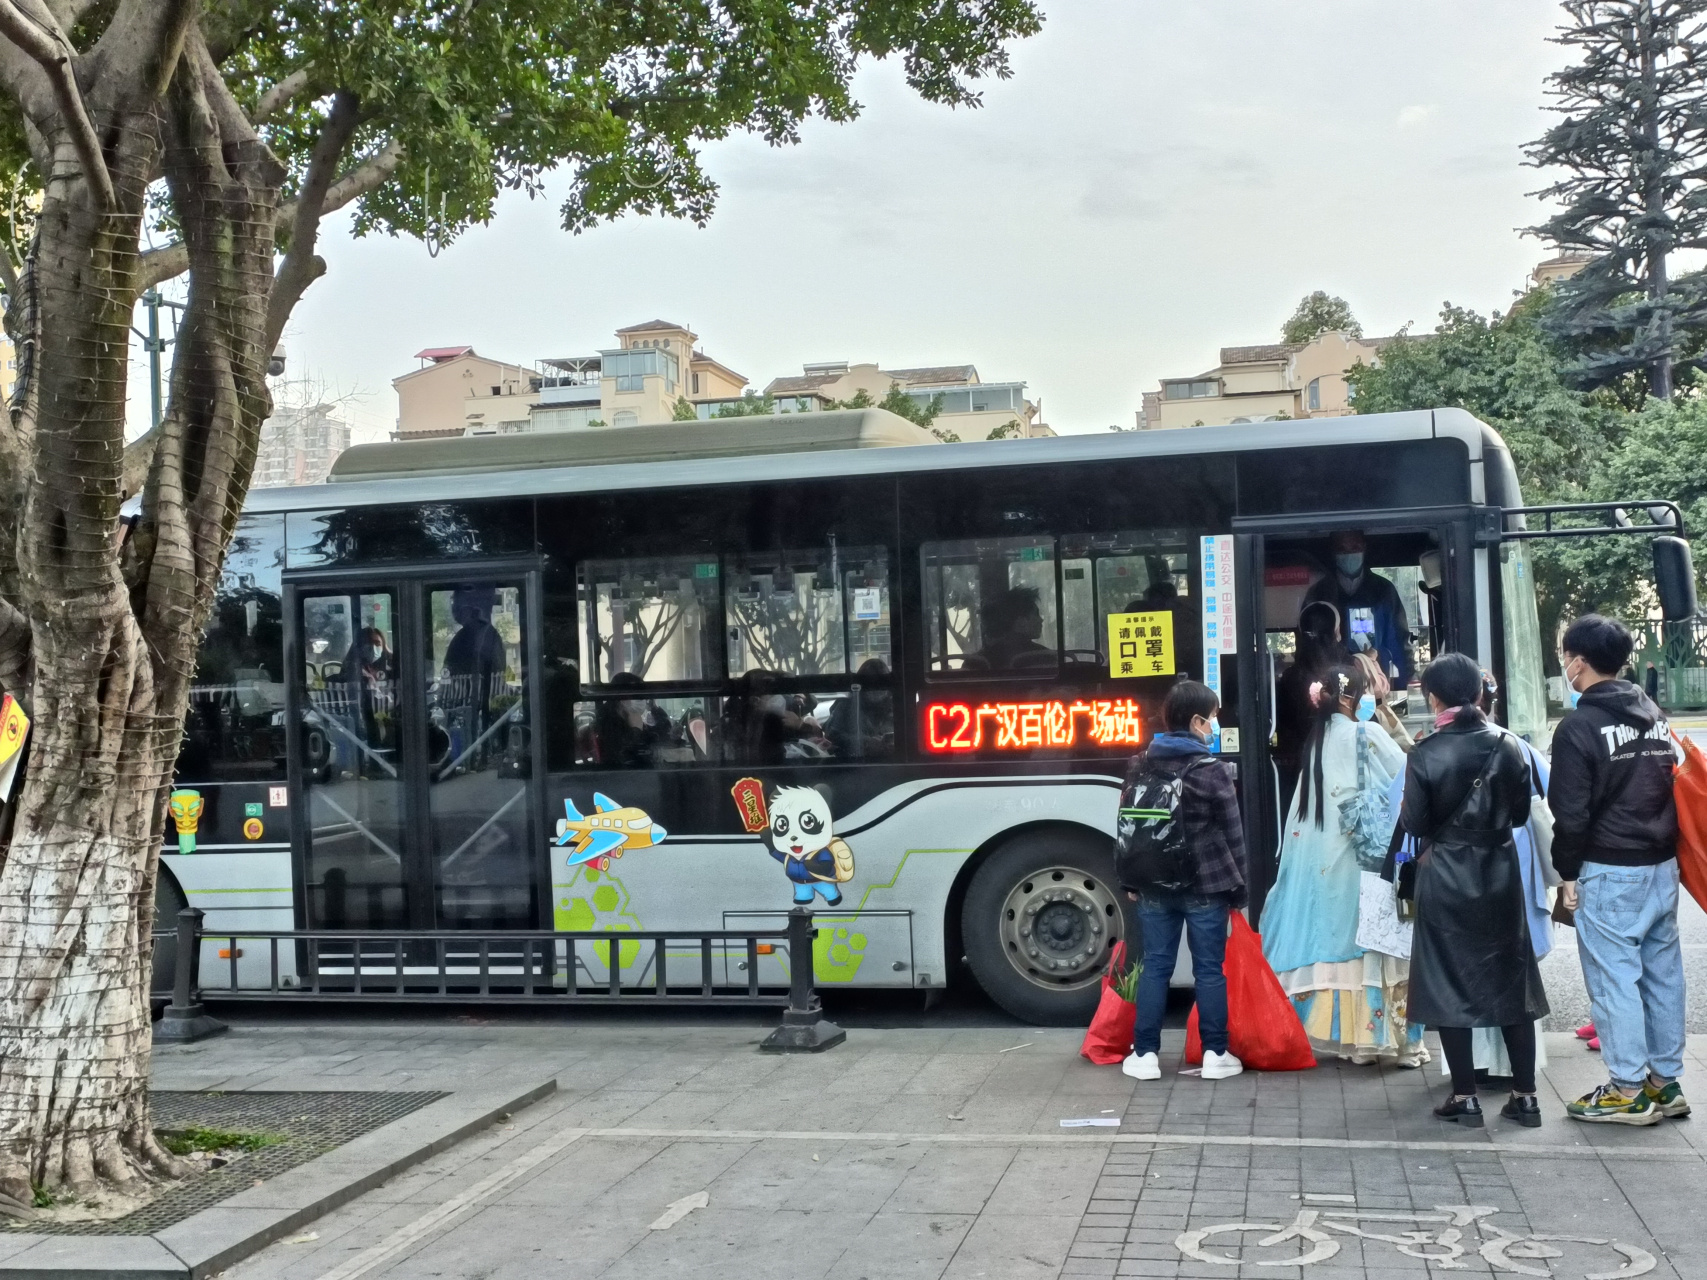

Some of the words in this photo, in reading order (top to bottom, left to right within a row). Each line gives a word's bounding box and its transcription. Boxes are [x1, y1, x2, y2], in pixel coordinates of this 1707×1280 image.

[1221, 540, 1231, 585] 直达公交
[1119, 625, 1162, 639] 请佩戴
[1120, 639, 1164, 659] 口罩
[1121, 660, 1164, 674] 乘车
[743, 790, 764, 825] 三星堆
